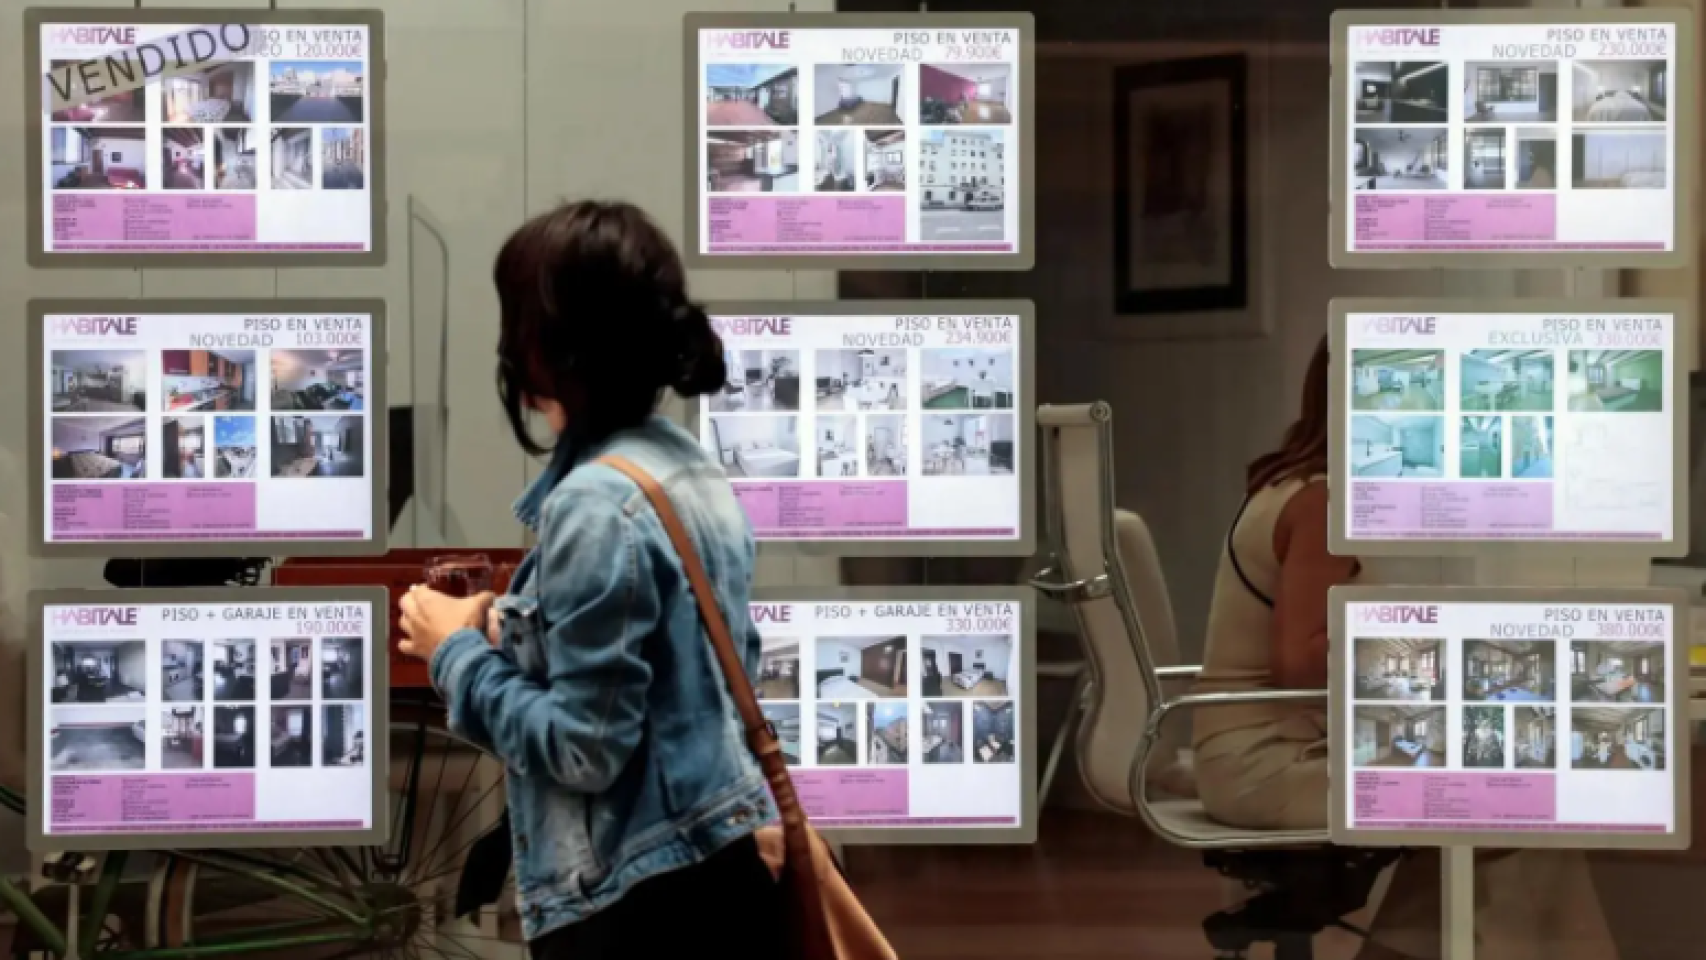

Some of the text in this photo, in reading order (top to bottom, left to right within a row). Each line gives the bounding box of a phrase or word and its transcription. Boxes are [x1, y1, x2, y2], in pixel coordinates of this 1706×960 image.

[286, 30, 306, 42] EN
[312, 30, 362, 42] VENTA
[893, 32, 1012, 45] PISO EN VENTA
[1547, 28, 1667, 42] PISO EN VENTA
[842, 45, 1002, 61] NOVEDAD 79.900€
[1493, 42, 1667, 58] NOVEDAD 230.000€
[46, 23, 250, 102] VENDIDO
[243, 318, 363, 331] PISO EN VENTA
[895, 317, 1013, 330] PISO EN VENTA
[1542, 318, 1663, 331] PISO EN VENTA
[189, 332, 362, 348] NOVEDAD 103.000€
[842, 331, 1012, 347] NOVEDAD 234.900€
[1488, 330, 1584, 345] EXCLUSIVA
[161, 607, 364, 621] PISO + GARAJE EN VENTA
[750, 604, 791, 623] TALE
[814, 603, 1013, 618] PISO + GARAJE EN VENTA
[1544, 608, 1665, 622] PISO EN VENTA
[296, 621, 363, 635] 190.000€
[1490, 623, 1574, 637] NOVEDAD
